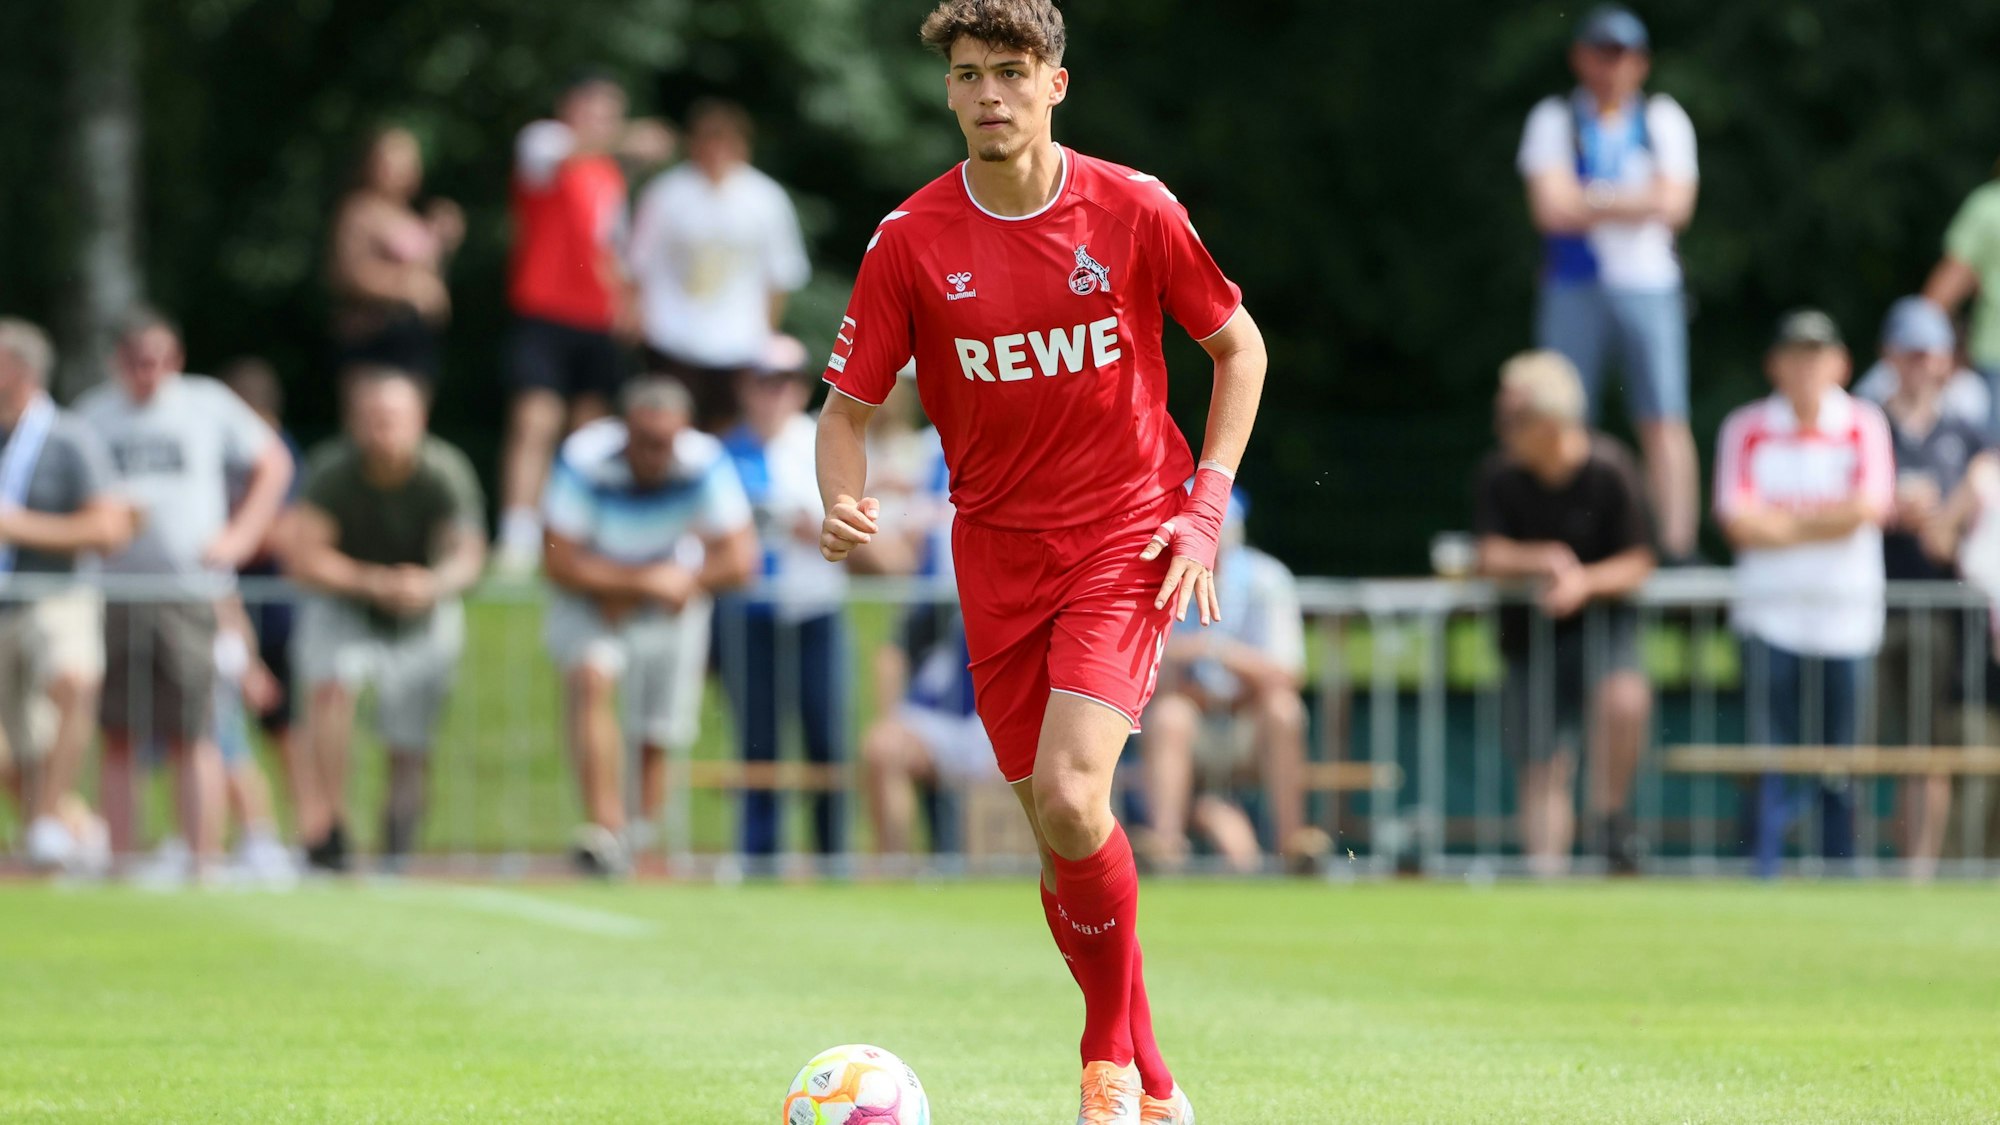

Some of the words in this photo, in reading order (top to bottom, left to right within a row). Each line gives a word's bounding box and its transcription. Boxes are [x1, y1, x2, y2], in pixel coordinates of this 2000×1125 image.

[946, 288, 977, 301] hummel
[954, 316, 1121, 382] REWE
[1071, 917, 1116, 935] KÖLN
